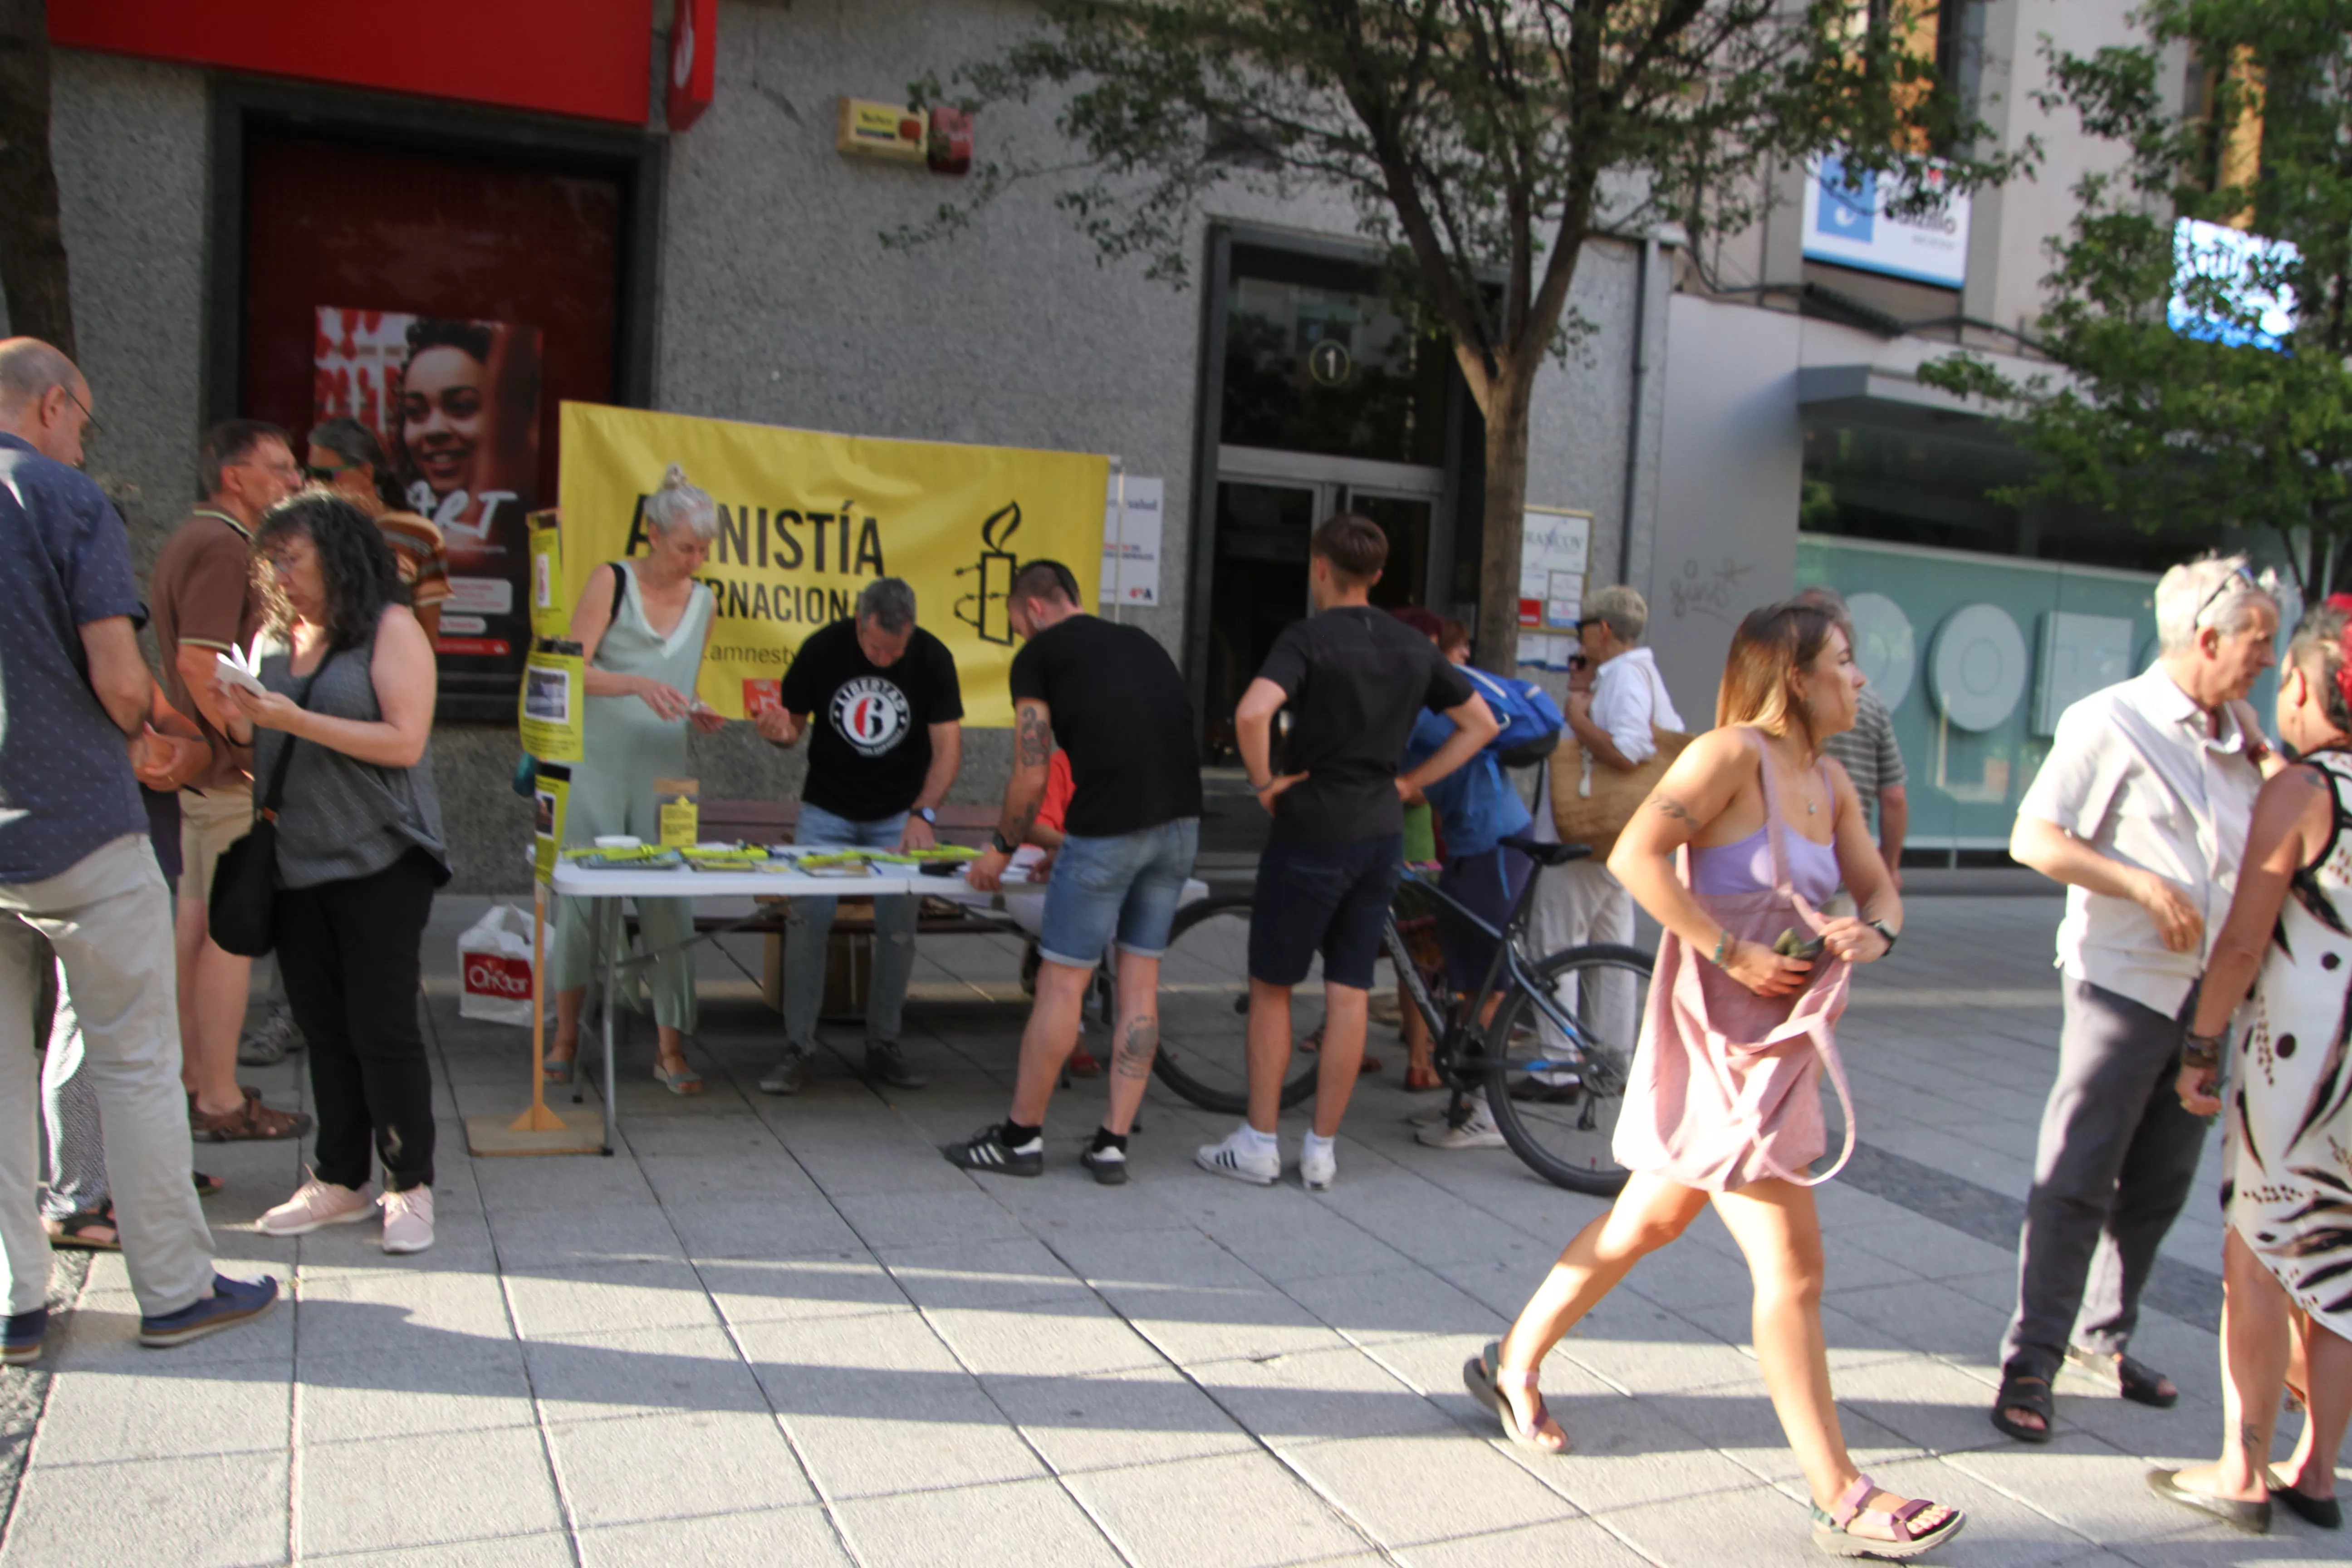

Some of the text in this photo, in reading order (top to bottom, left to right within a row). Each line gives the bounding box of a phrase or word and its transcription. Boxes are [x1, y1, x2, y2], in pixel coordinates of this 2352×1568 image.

[1325, 348, 1336, 380] 1
[404, 480, 518, 539] ART
[625, 494, 884, 577] ANISTÍA
[691, 576, 865, 624] RNACION
